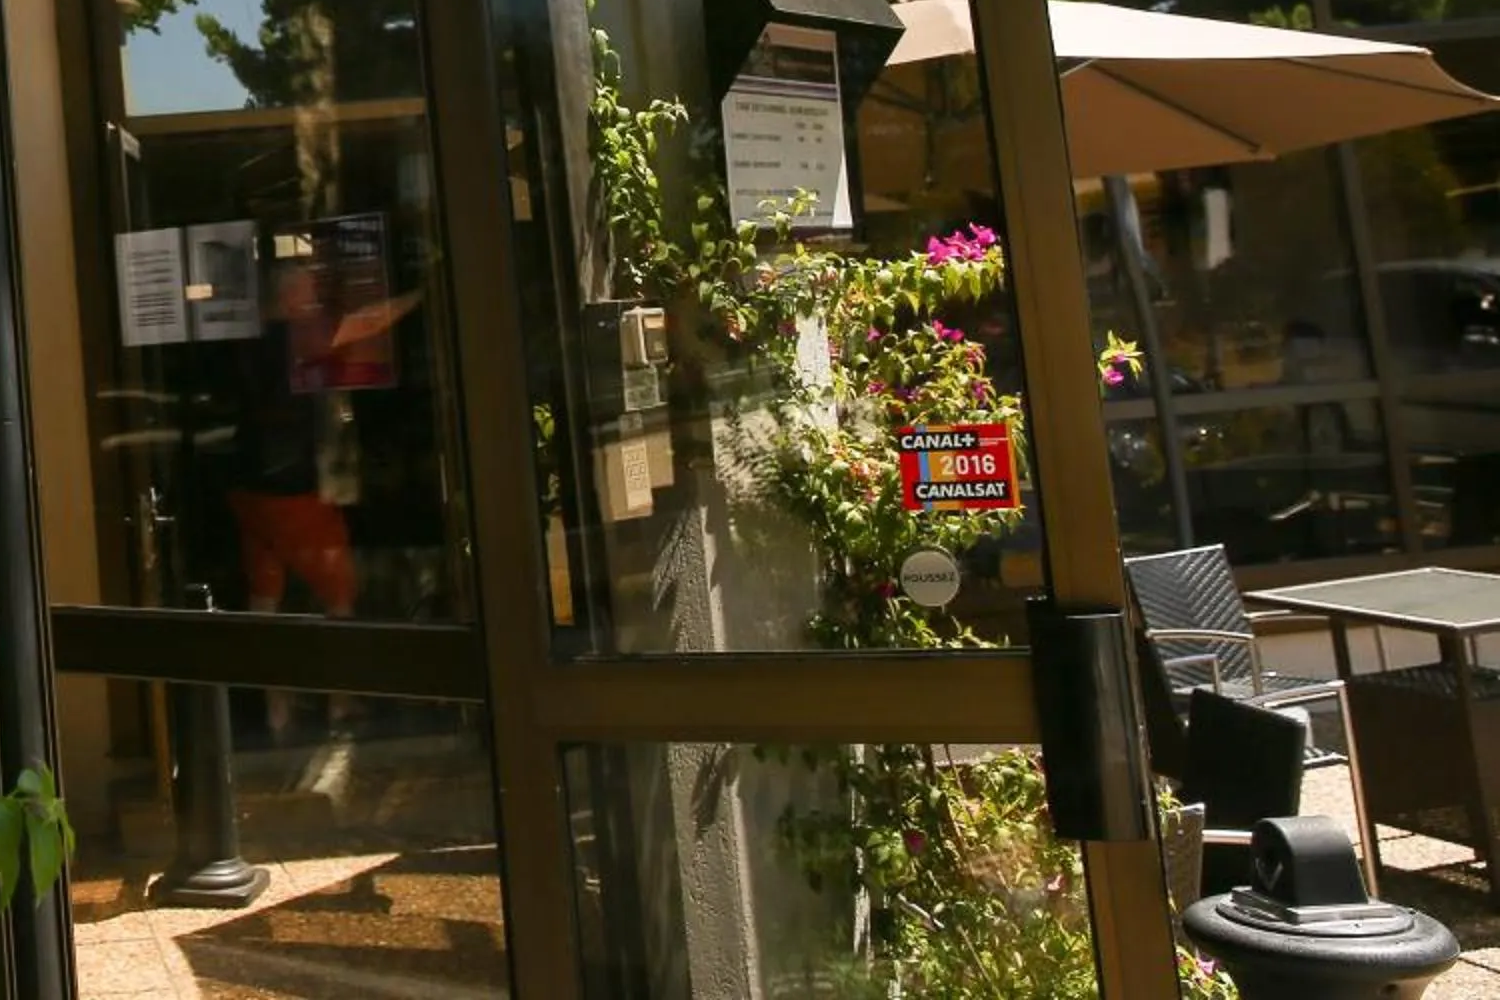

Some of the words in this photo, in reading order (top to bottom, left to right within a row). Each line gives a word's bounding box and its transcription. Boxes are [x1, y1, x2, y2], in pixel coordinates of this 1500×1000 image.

[901, 433, 976, 449] CANAL+
[940, 453, 997, 475] 2016
[915, 482, 1006, 499] CANALSAT
